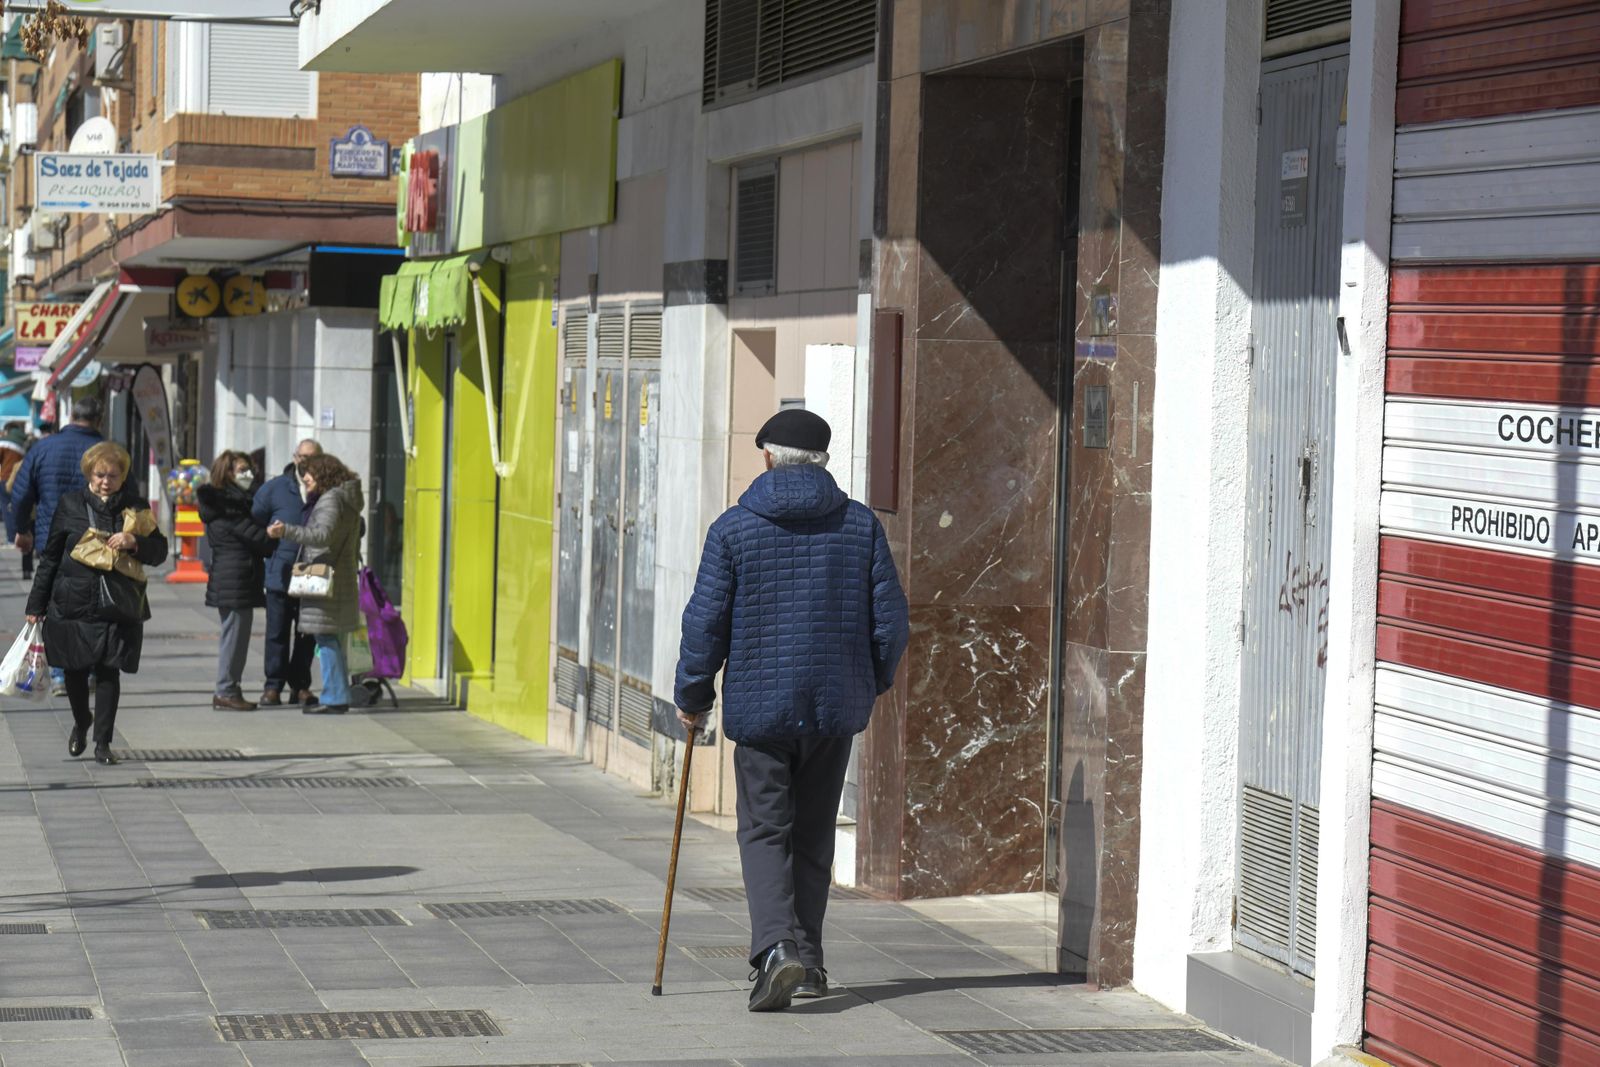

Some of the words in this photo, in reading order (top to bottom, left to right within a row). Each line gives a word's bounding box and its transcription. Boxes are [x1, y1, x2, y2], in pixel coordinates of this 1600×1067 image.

[41, 156, 82, 177] Saez
[86, 159, 102, 177] de
[103, 160, 149, 182] Tejada
[20, 321, 47, 337] LA
[1451, 505, 1550, 544] PROHIBIDO
[1571, 522, 1600, 552] AP
